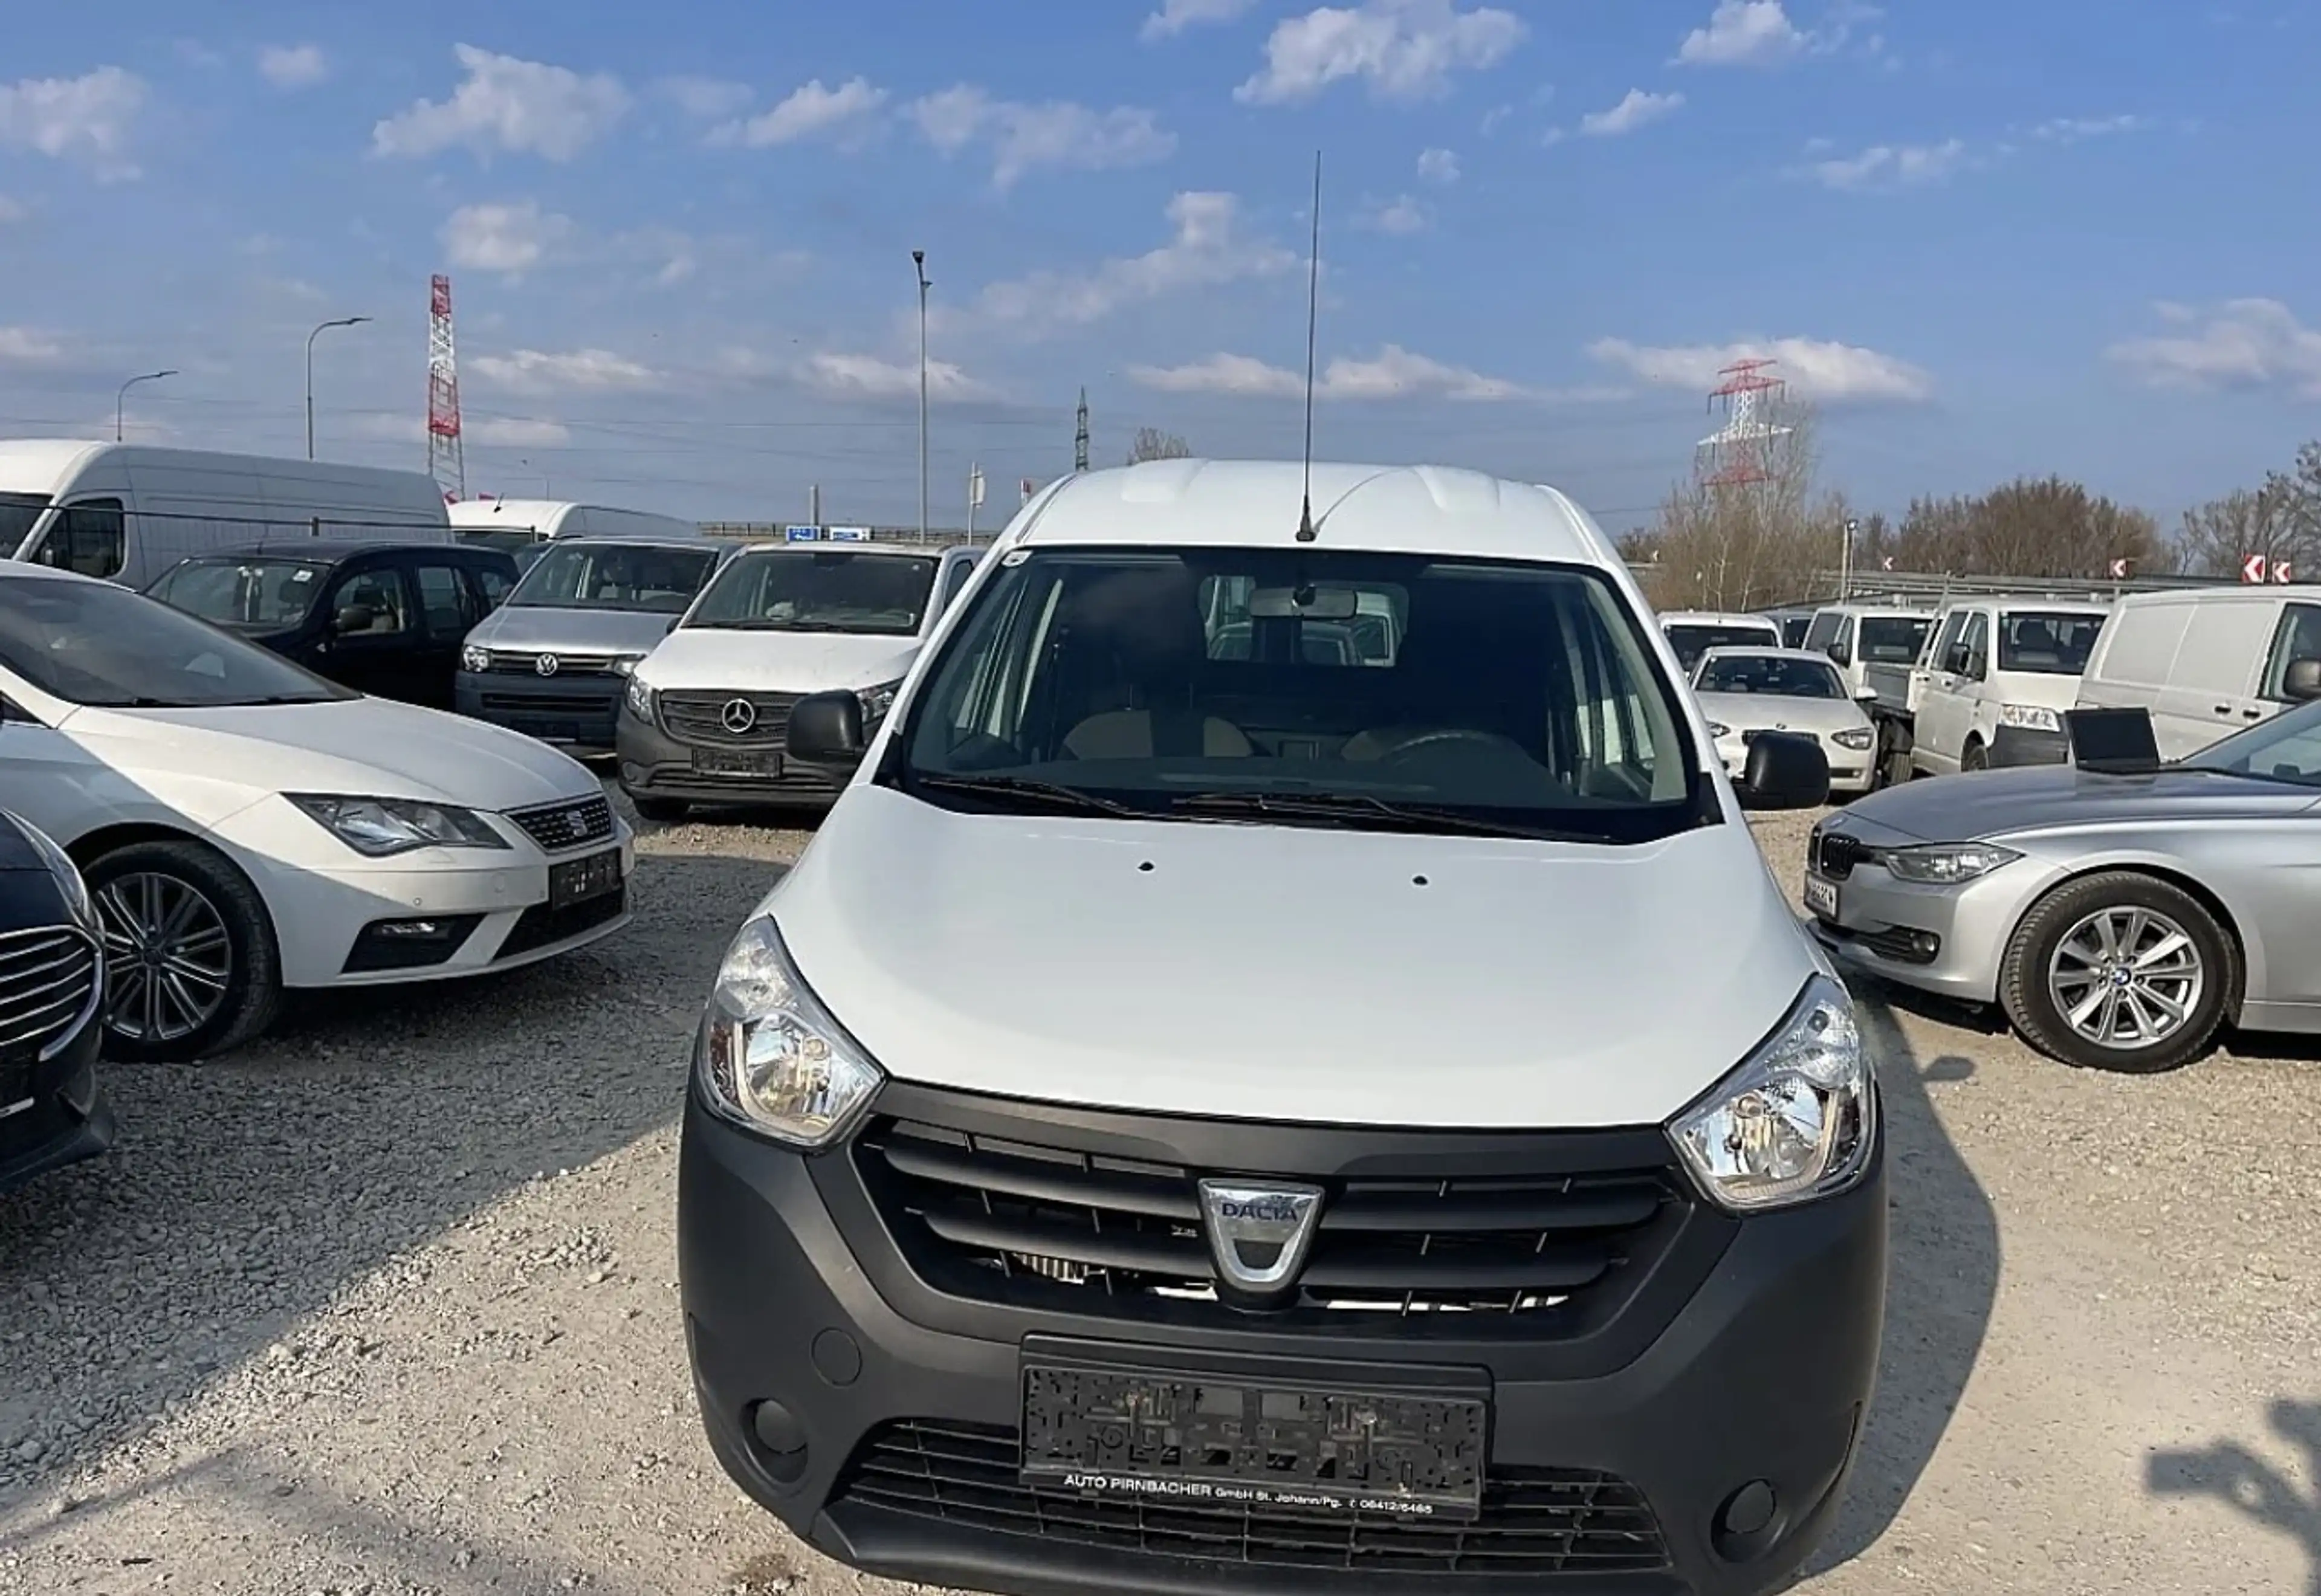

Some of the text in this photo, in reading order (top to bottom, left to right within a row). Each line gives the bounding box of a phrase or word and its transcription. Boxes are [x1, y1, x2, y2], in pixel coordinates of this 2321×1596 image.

[1221, 1203, 1298, 1222] DACIA
[1064, 1474, 1107, 1489] AUTO
[1110, 1478, 1211, 1496] PIRNBACHER
[1215, 1487, 1253, 1500] GmbH
[1256, 1490, 1272, 1501] St.
